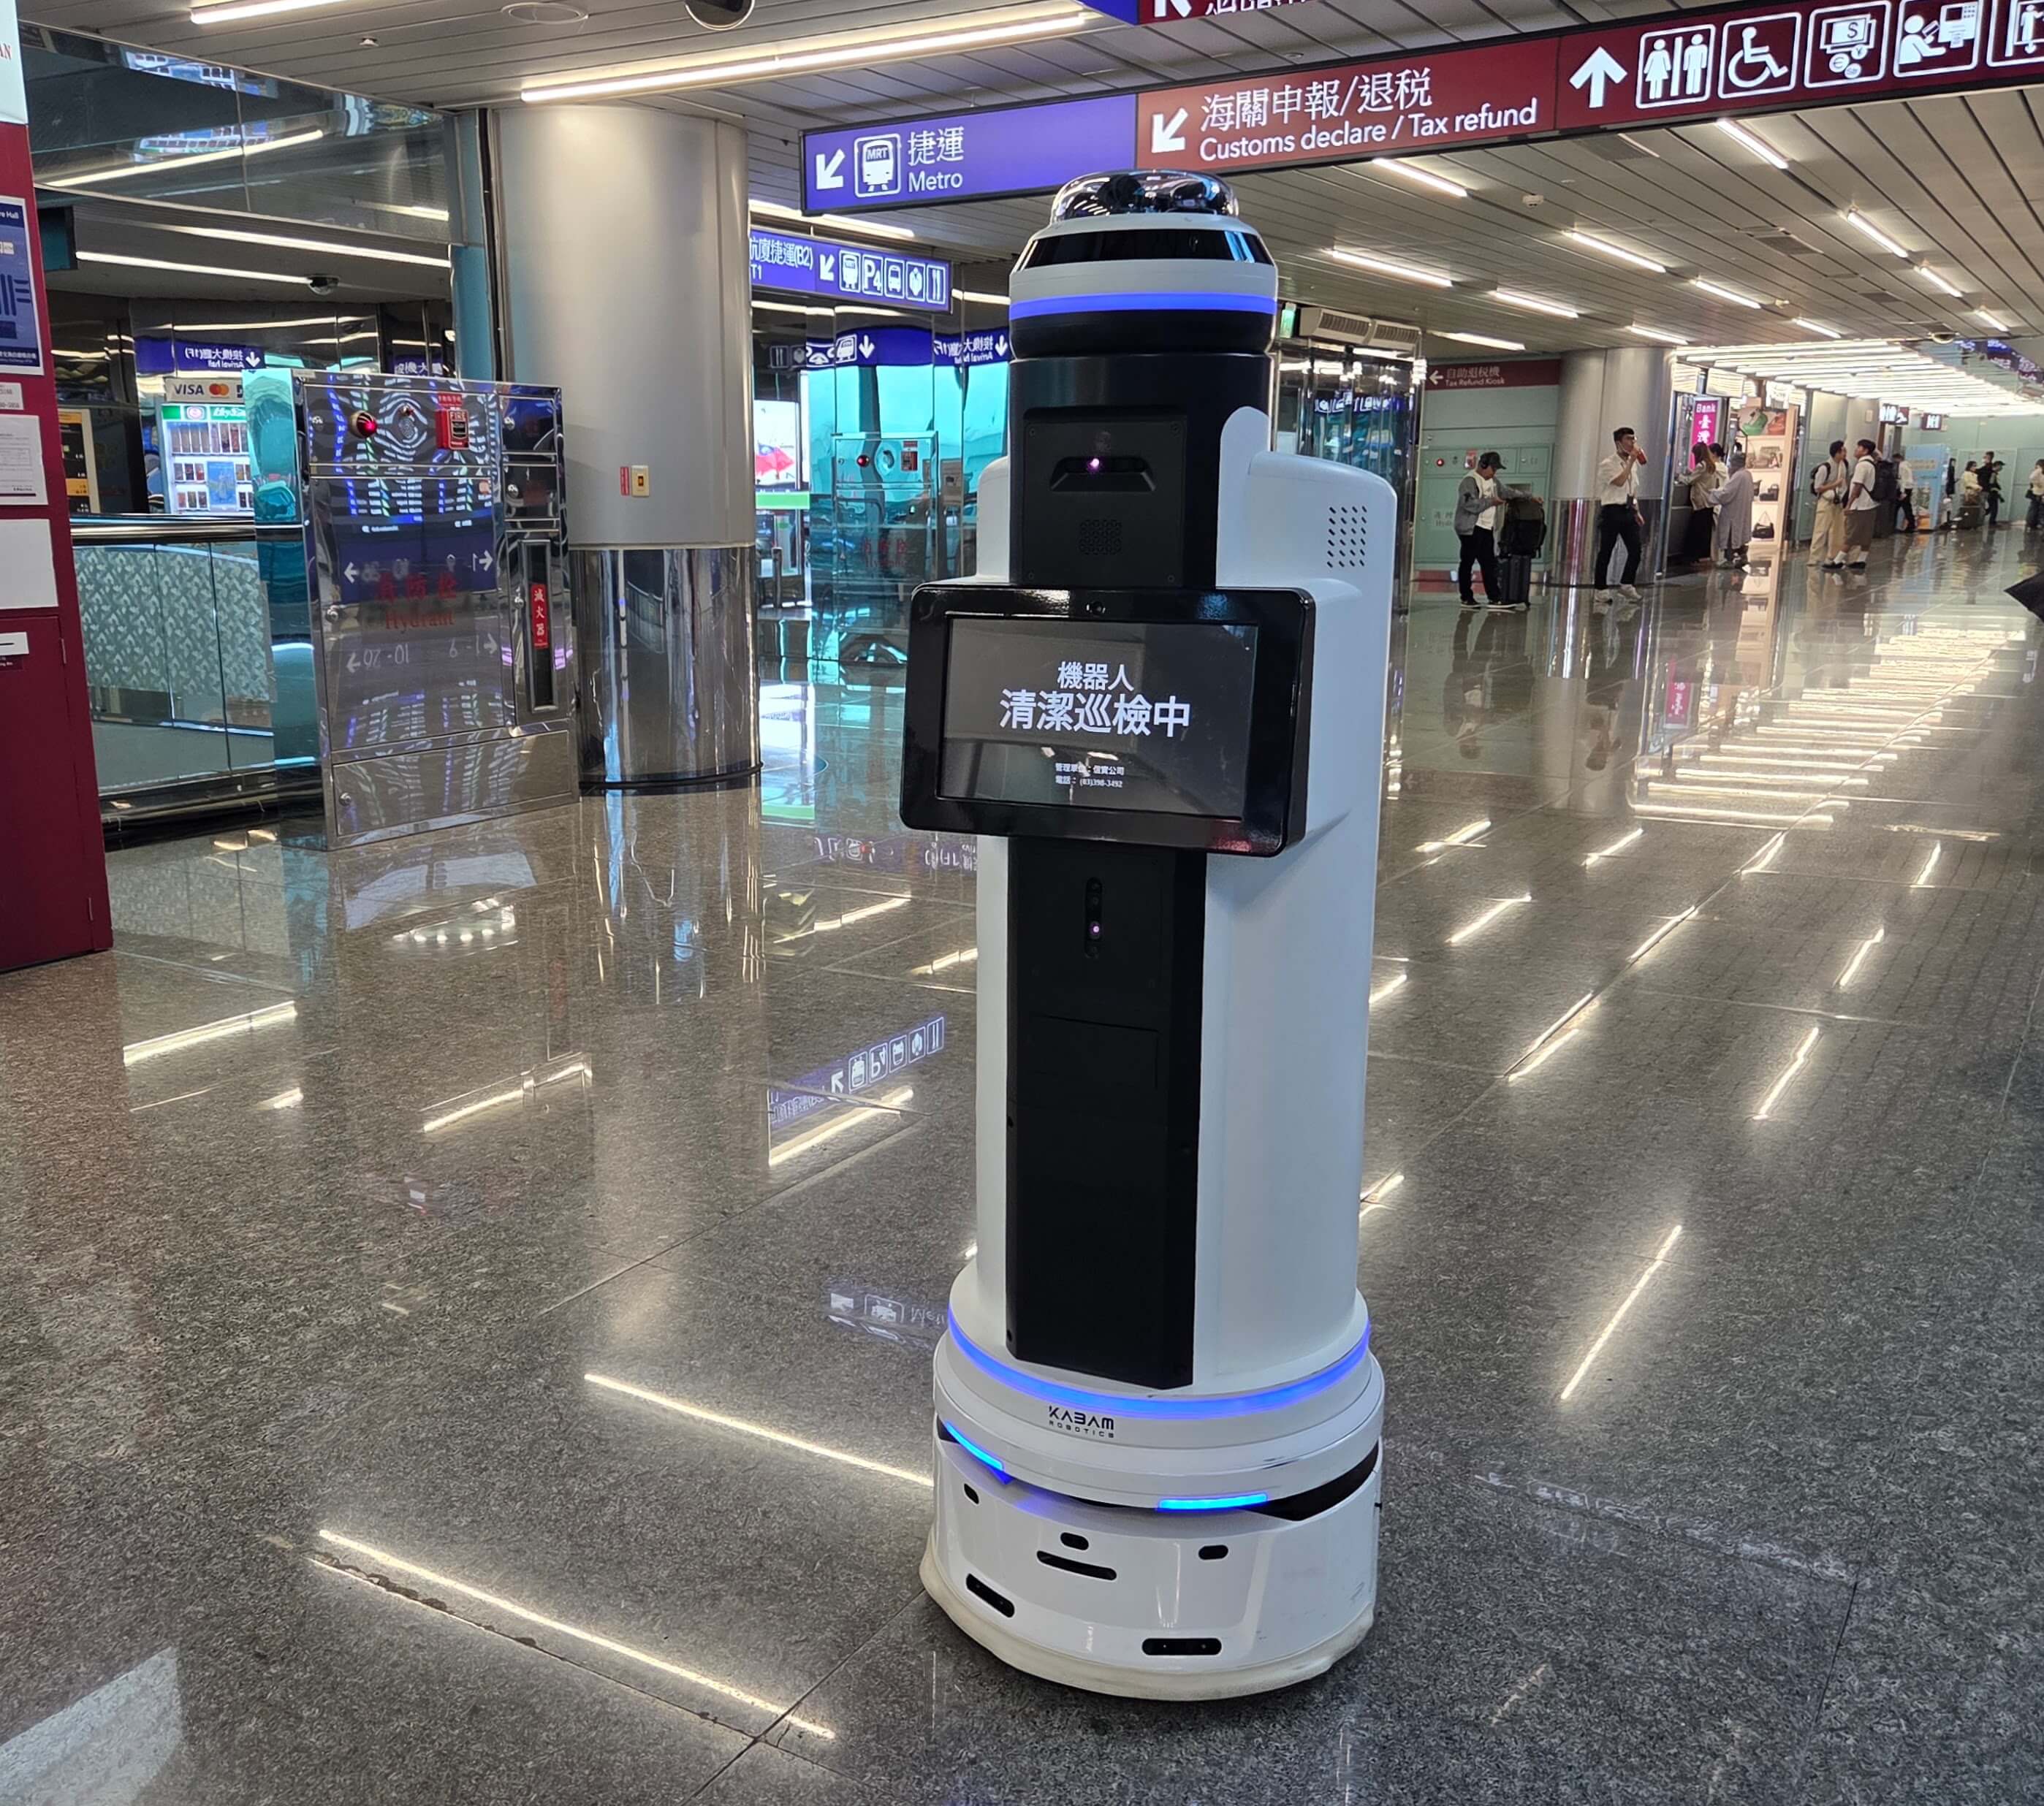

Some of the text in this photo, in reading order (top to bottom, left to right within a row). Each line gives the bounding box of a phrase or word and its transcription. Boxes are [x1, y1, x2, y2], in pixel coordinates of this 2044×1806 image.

[1200, 133, 1295, 161] Customs
[1301, 124, 1386, 150] declare
[1409, 113, 1447, 137] Tax
[1454, 98, 1538, 132] refund
[867, 147, 888, 160] MRT
[908, 126, 965, 167] 捷運
[908, 171, 963, 192] Metro
[175, 384, 204, 395] VISA
[1485, 377, 1505, 385] Kiosk
[1696, 403, 1716, 413] Bank
[1057, 660, 1134, 692] 機器人
[999, 689, 1191, 738] 清潔巡檢中
[1049, 1405, 1114, 1430] KABAM
[1049, 1420, 1114, 1439] ROBOTICS
